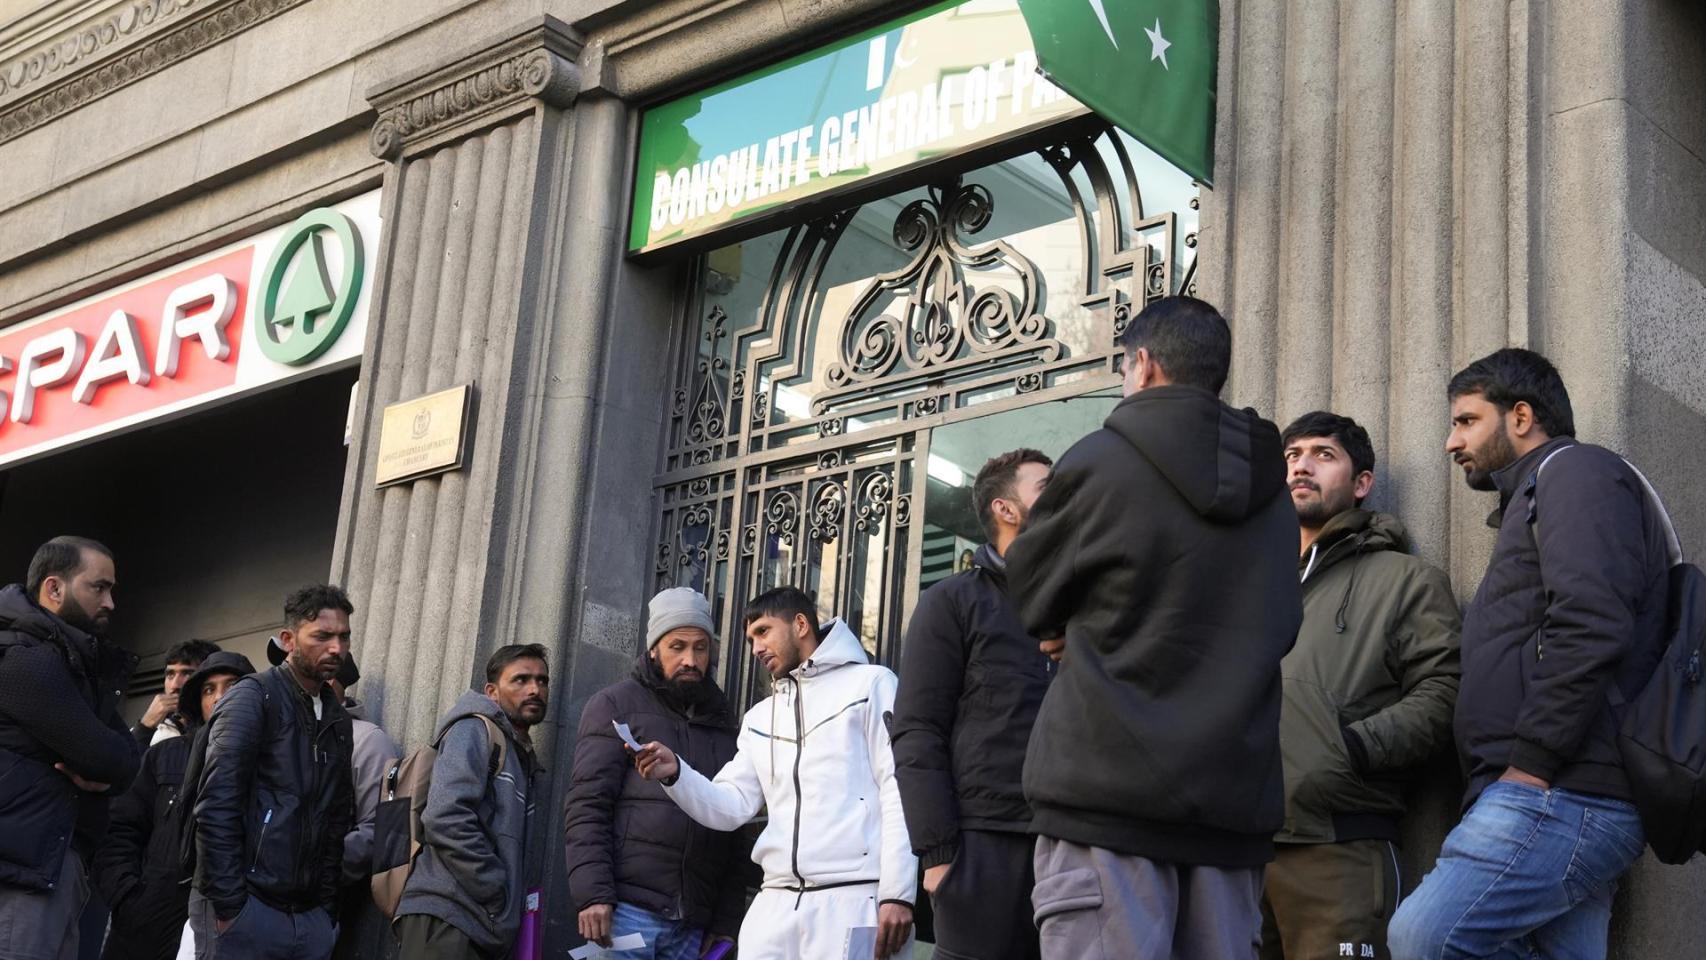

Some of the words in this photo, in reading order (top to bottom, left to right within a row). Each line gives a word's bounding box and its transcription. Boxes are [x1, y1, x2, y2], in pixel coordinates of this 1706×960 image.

[650, 124, 814, 232] CONSULATE
[817, 74, 955, 179] GENERAL
[960, 58, 1008, 131] OF
[0, 273, 237, 426] PAR
